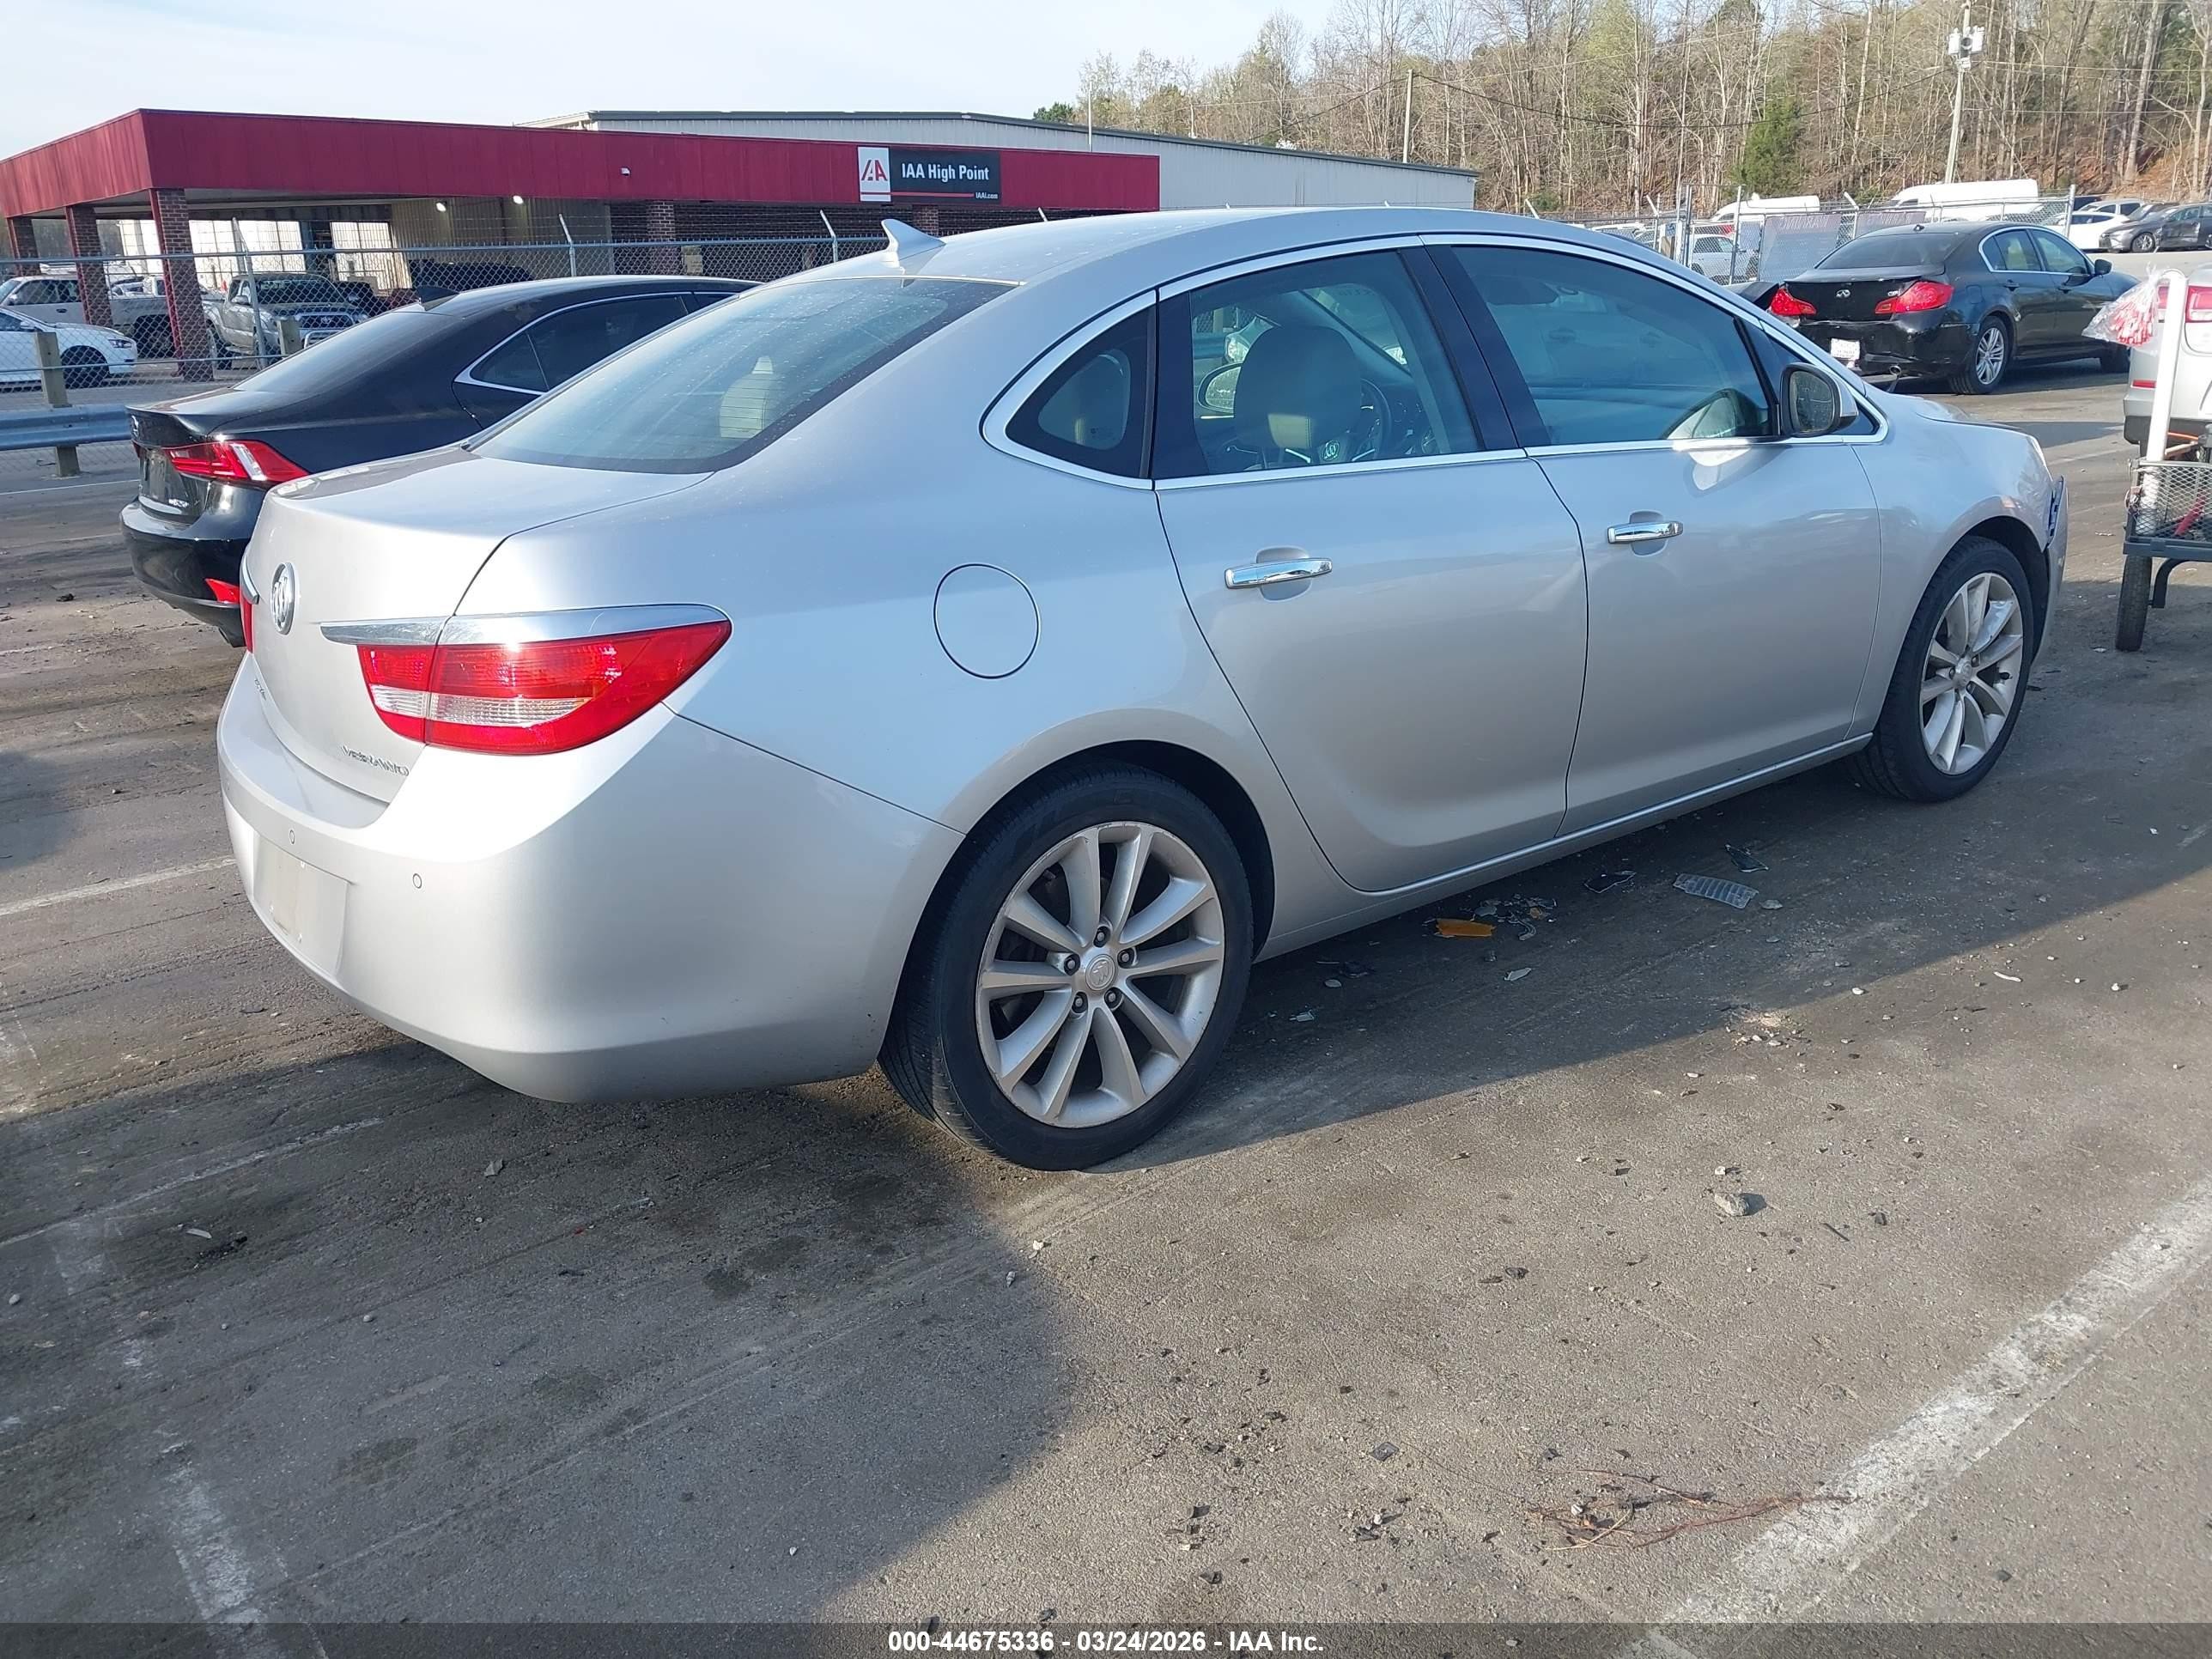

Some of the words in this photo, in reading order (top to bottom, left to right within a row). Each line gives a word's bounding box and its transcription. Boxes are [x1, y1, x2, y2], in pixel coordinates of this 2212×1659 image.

[902, 163, 925, 179] IAA
[928, 163, 957, 183] High
[959, 165, 989, 180] Point
